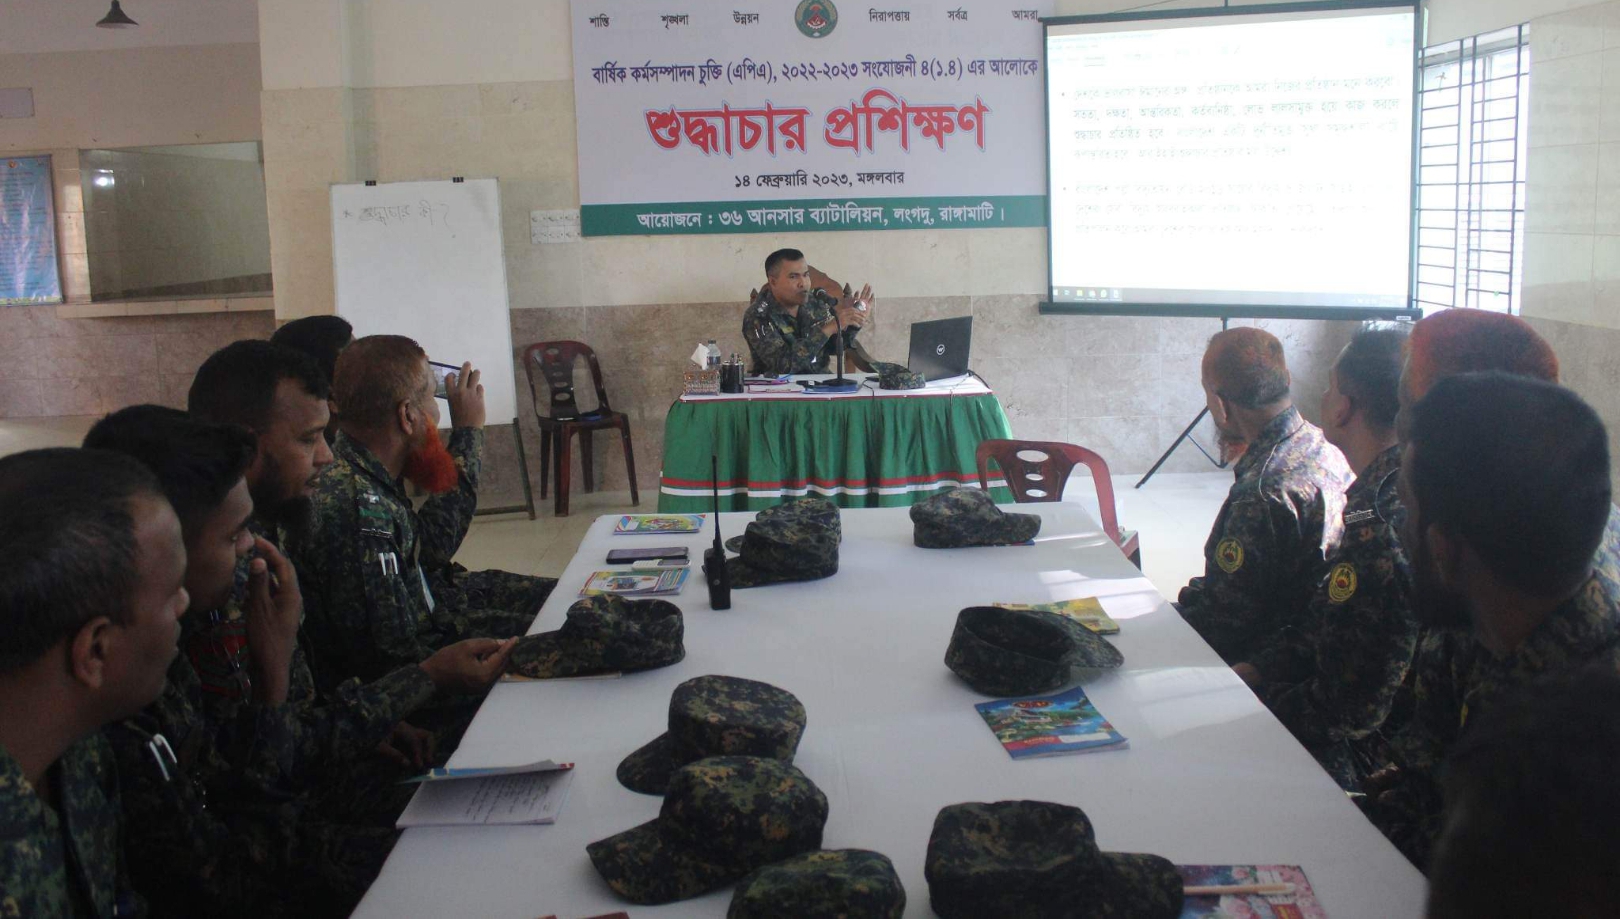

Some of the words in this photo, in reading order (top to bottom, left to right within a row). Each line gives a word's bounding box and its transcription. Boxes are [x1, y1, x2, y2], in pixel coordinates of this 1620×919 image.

[733, 10, 760, 26] উন্নয়ন
[1012, 8, 1039, 21] আমরা
[592, 60, 627, 85] বার্ষিক
[630, 60, 695, 83] কর্মসম্পাদন
[698, 58, 723, 87] চুক্তি
[782, 61, 858, 82] ২০২২-২০২৩
[861, 54, 917, 80] সংযোজনী
[921, 57, 963, 81] ৪(১.৪)
[967, 59, 985, 77] এর
[989, 56, 1038, 77] আলোকে
[645, 100, 811, 158] শুদ্ধাচার
[824, 87, 990, 156] প্রশিক্ষণ
[735, 174, 751, 188] ১৪
[756, 169, 808, 189] ফেব্রুয়ারি
[812, 172, 853, 187] ২০২৩,
[856, 170, 905, 185] মঙ্গলবার
[636, 211, 702, 229] আয়োজনে
[718, 210, 743, 226] ৩৬
[746, 206, 805, 227] আনসার
[809, 202, 888, 226] ব্যাটালিয়ন,
[894, 205, 935, 225] লংগদু,
[938, 202, 995, 222] রাঙ্গামাটি
